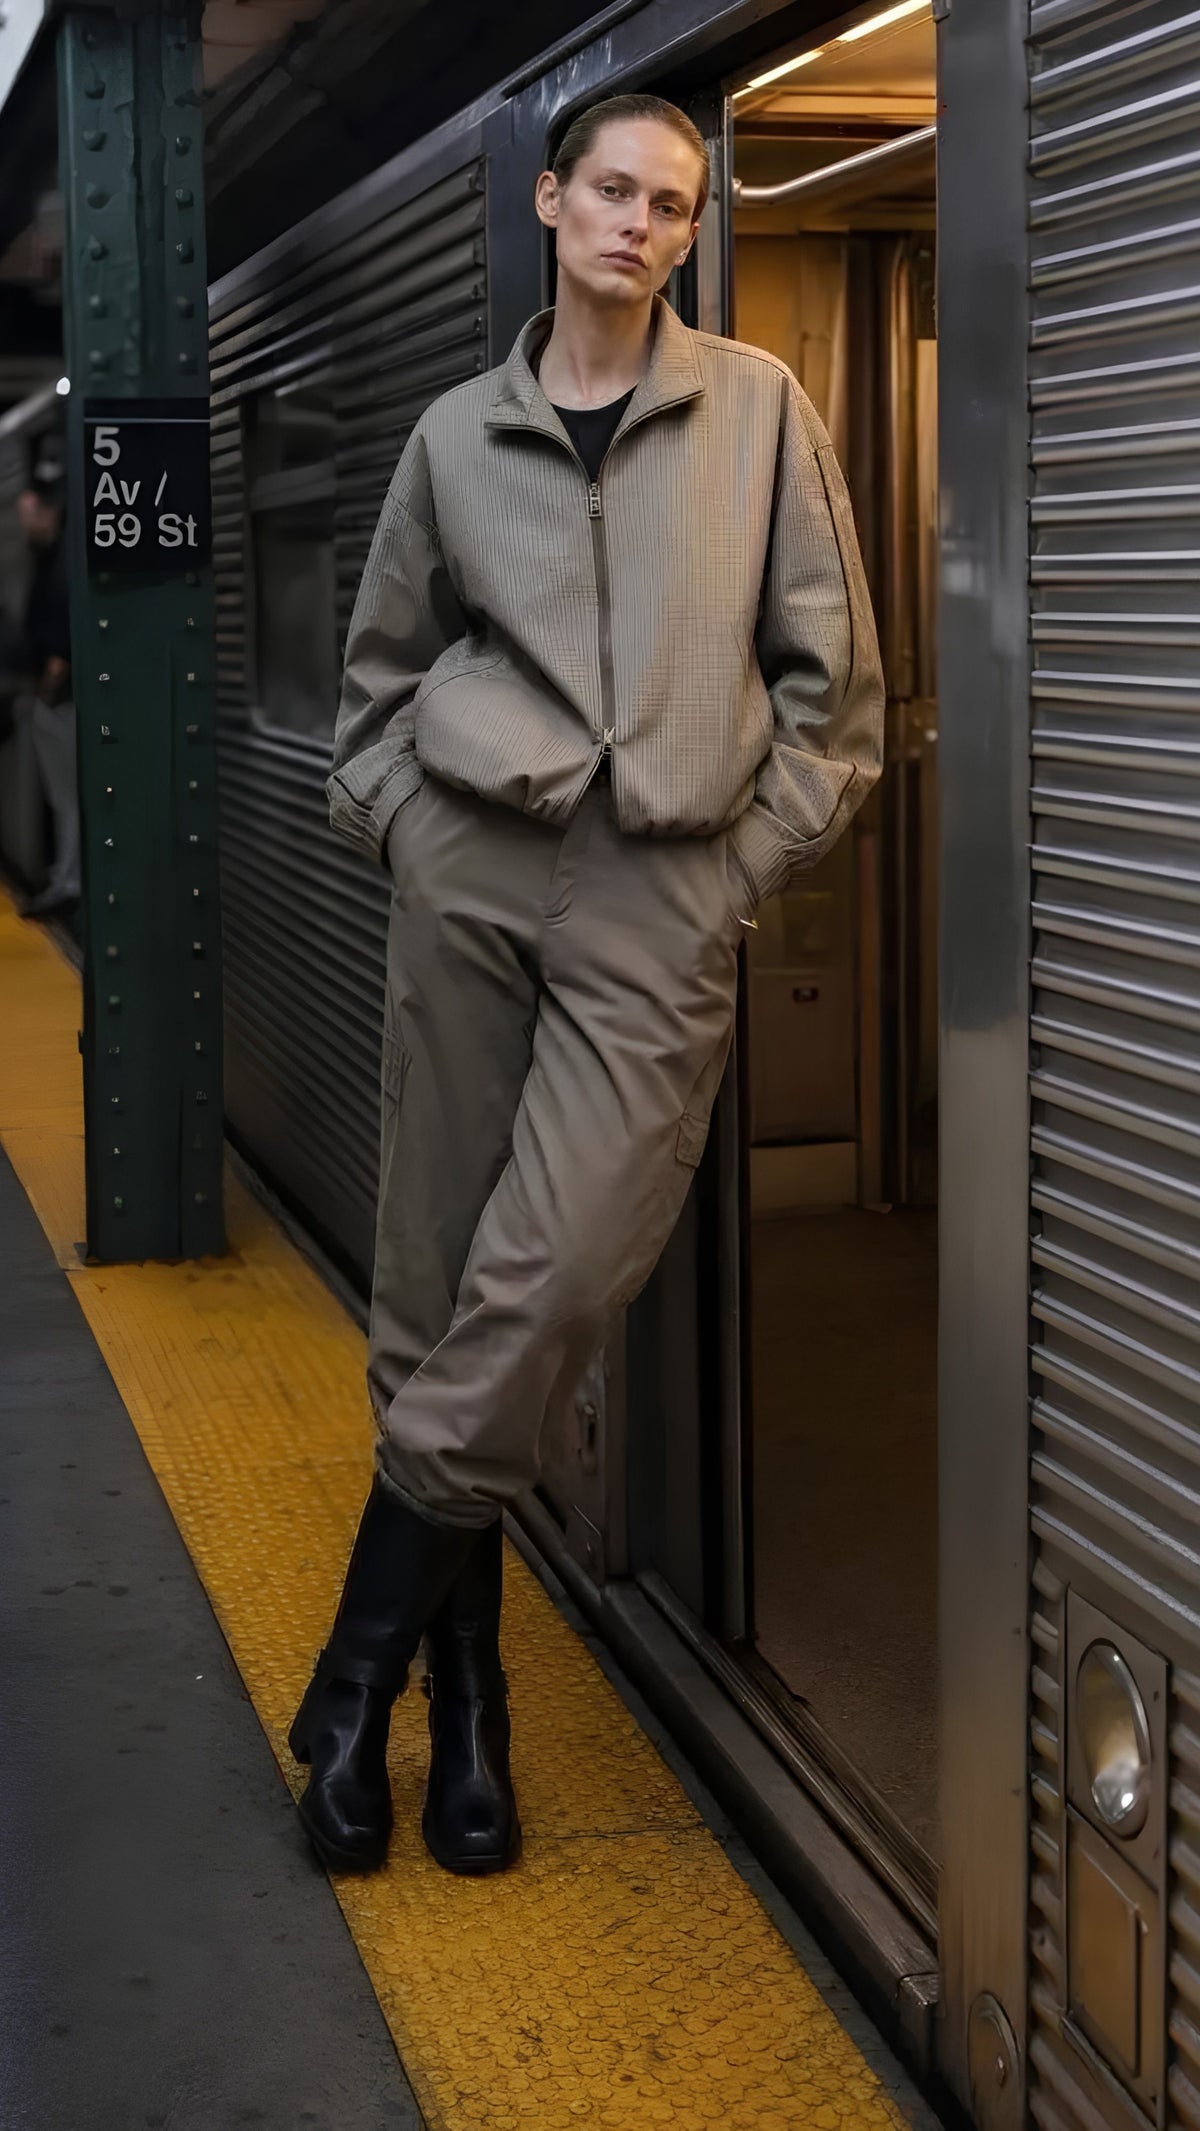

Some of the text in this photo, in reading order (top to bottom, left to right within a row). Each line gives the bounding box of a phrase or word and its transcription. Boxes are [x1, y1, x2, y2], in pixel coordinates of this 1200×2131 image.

[92, 426, 121, 466] 5
[93, 471, 141, 508] Av
[94, 513, 199, 548] 59 St
